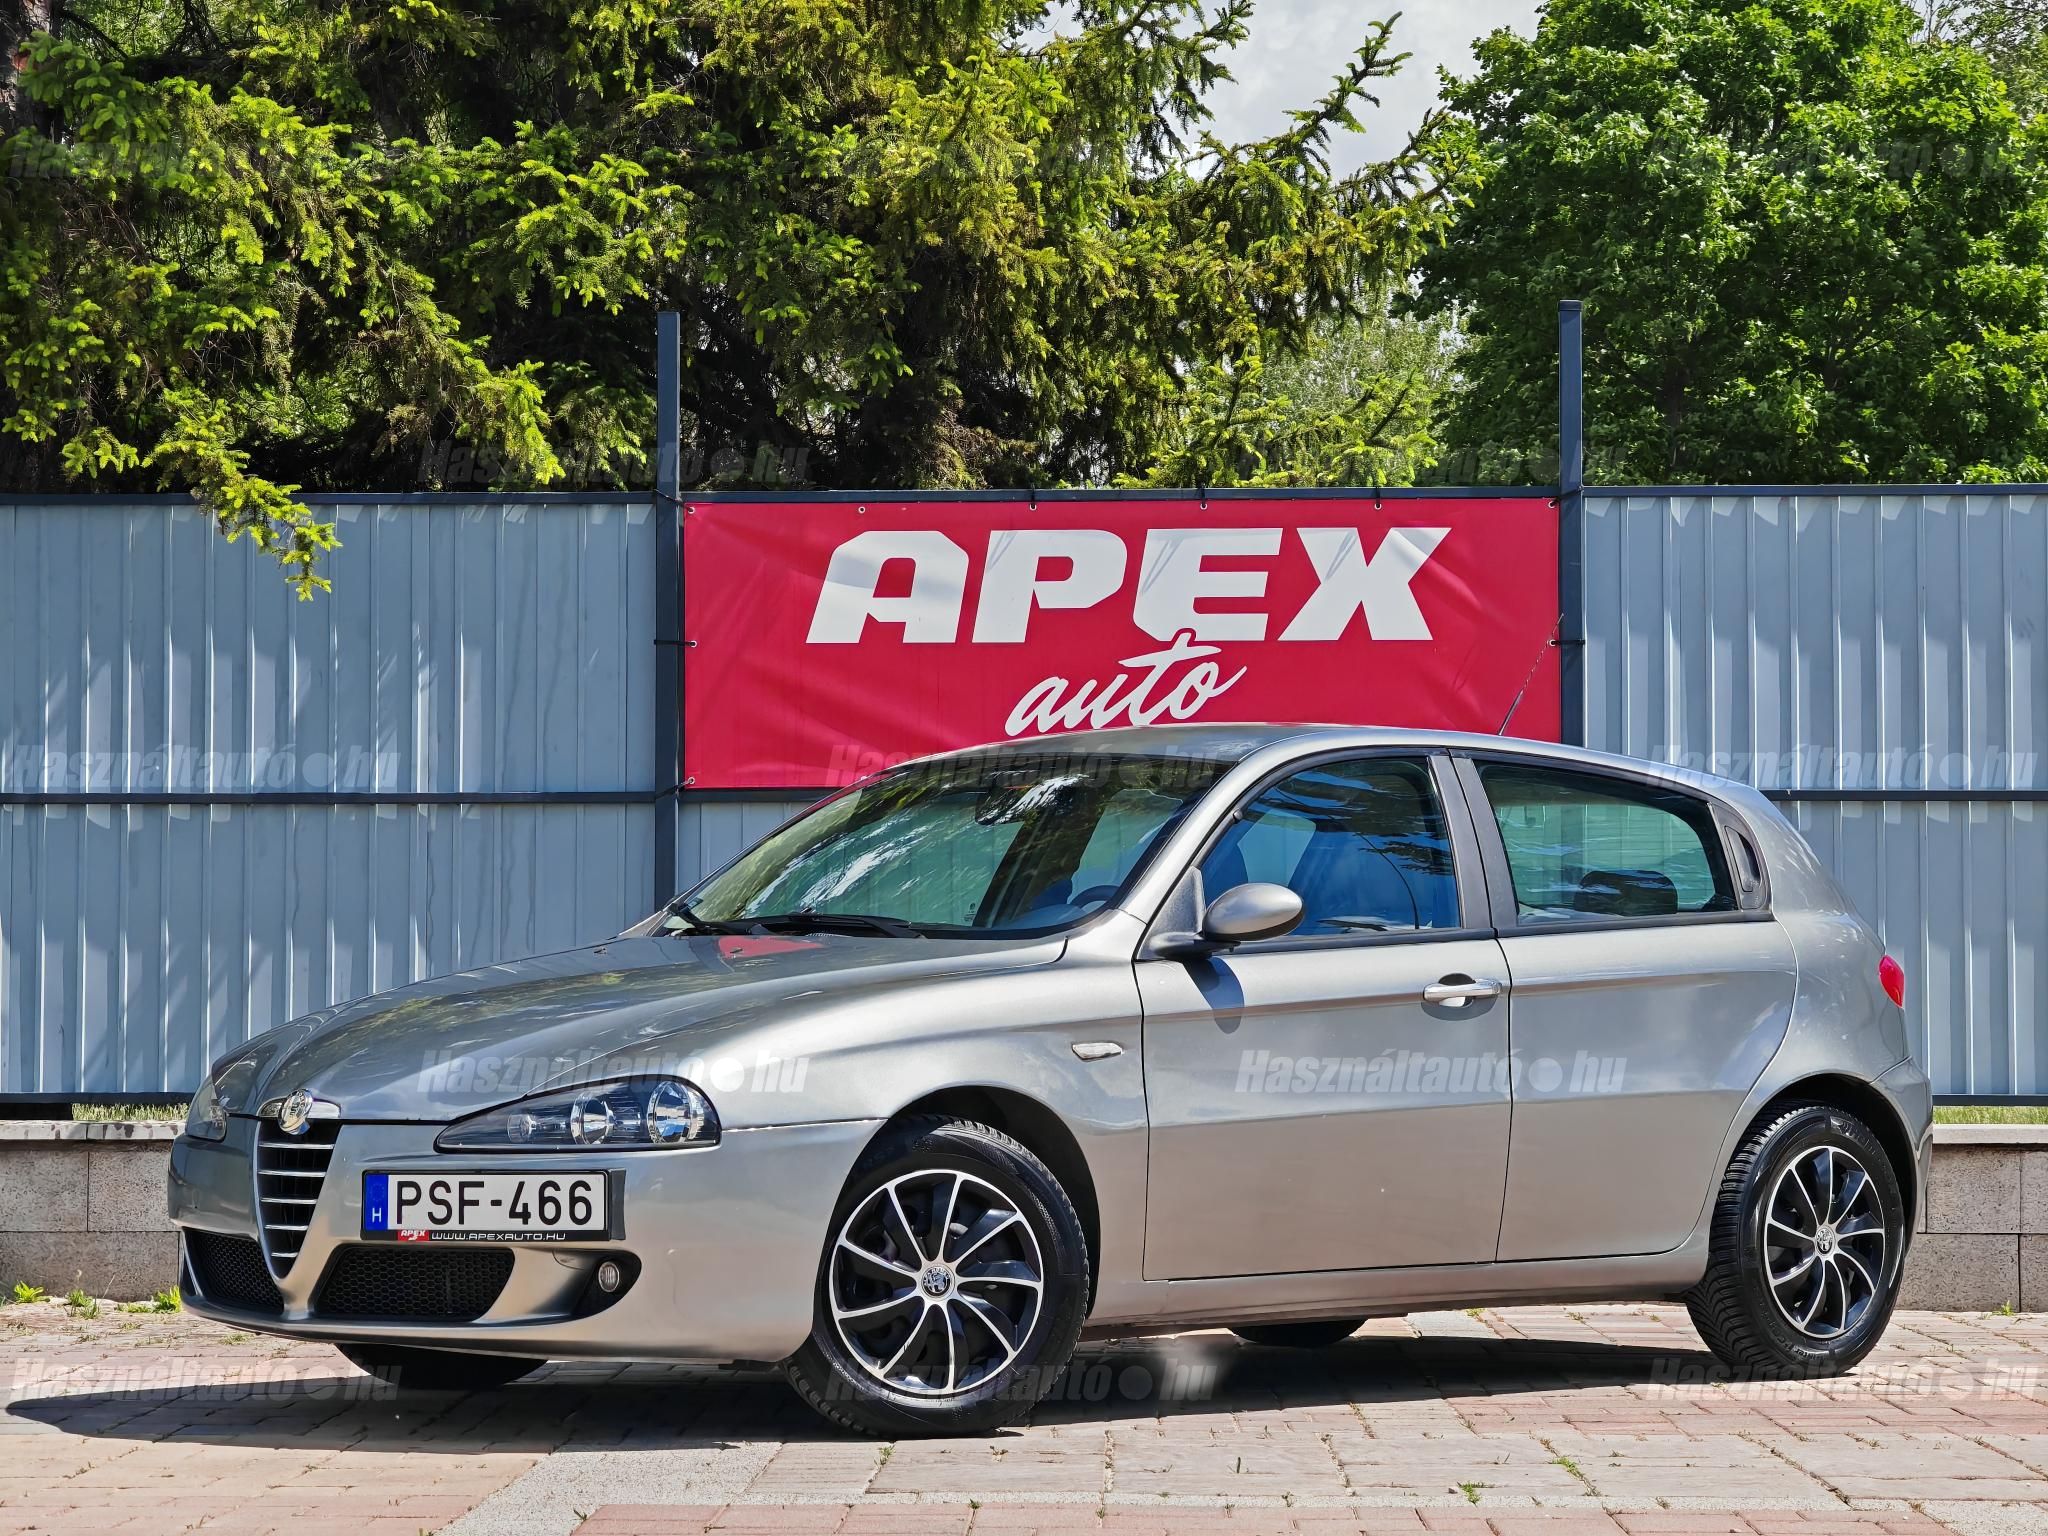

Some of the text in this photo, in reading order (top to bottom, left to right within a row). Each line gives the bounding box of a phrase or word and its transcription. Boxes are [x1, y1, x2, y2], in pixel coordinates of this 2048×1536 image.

[805, 527, 1452, 643] APEX
[1005, 632, 1247, 736] auto
[372, 1207, 382, 1223] H
[397, 1180, 592, 1225] PSF-466
